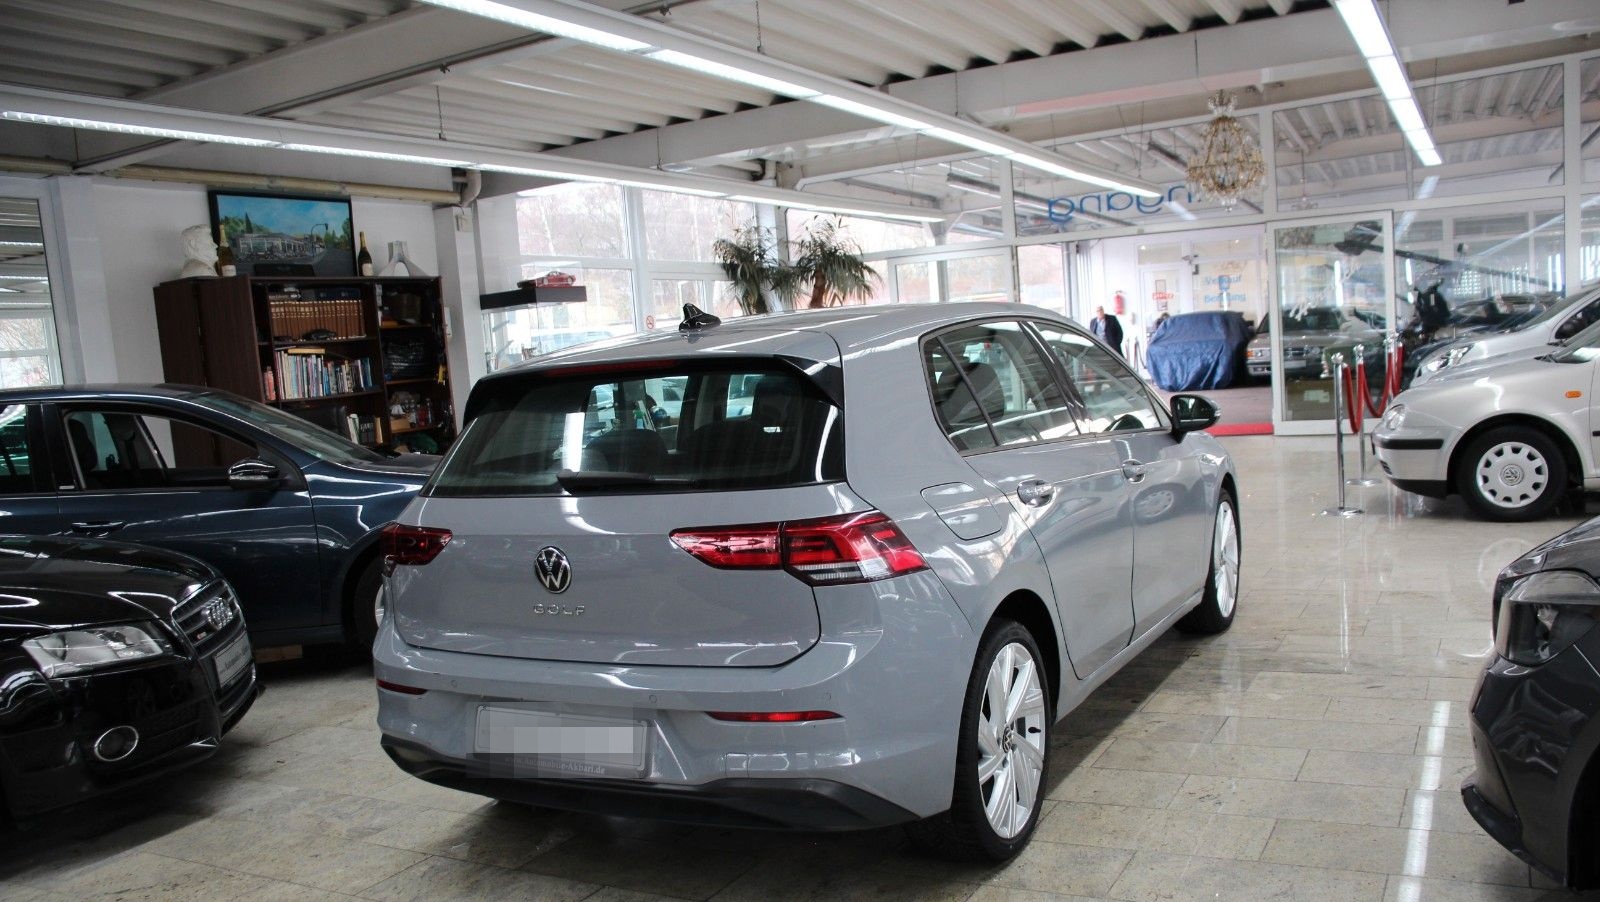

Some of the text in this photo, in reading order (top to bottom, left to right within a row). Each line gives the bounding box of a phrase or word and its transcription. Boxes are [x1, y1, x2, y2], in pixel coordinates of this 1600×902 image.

[1205, 274, 1242, 285] Verauf
[1204, 293, 1247, 304] Berung
[534, 603, 585, 616] GOLF
